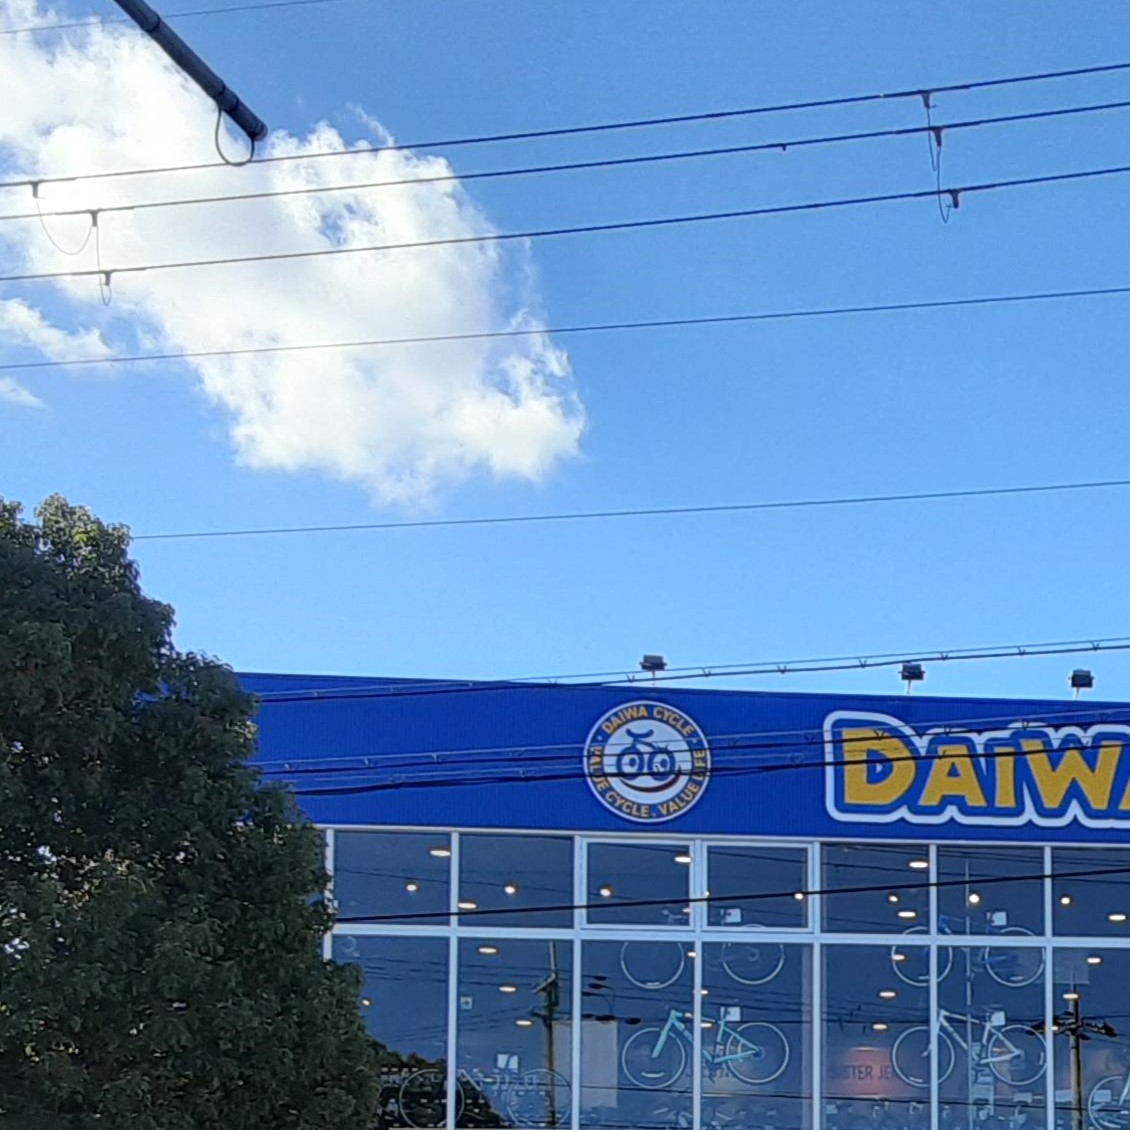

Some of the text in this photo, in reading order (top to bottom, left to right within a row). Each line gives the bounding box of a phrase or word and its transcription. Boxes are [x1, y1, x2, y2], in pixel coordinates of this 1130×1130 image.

[601, 706, 695, 737] DAIWA CYCLE
[605, 790, 650, 818] CYCLE
[658, 782, 700, 815] VALUE
